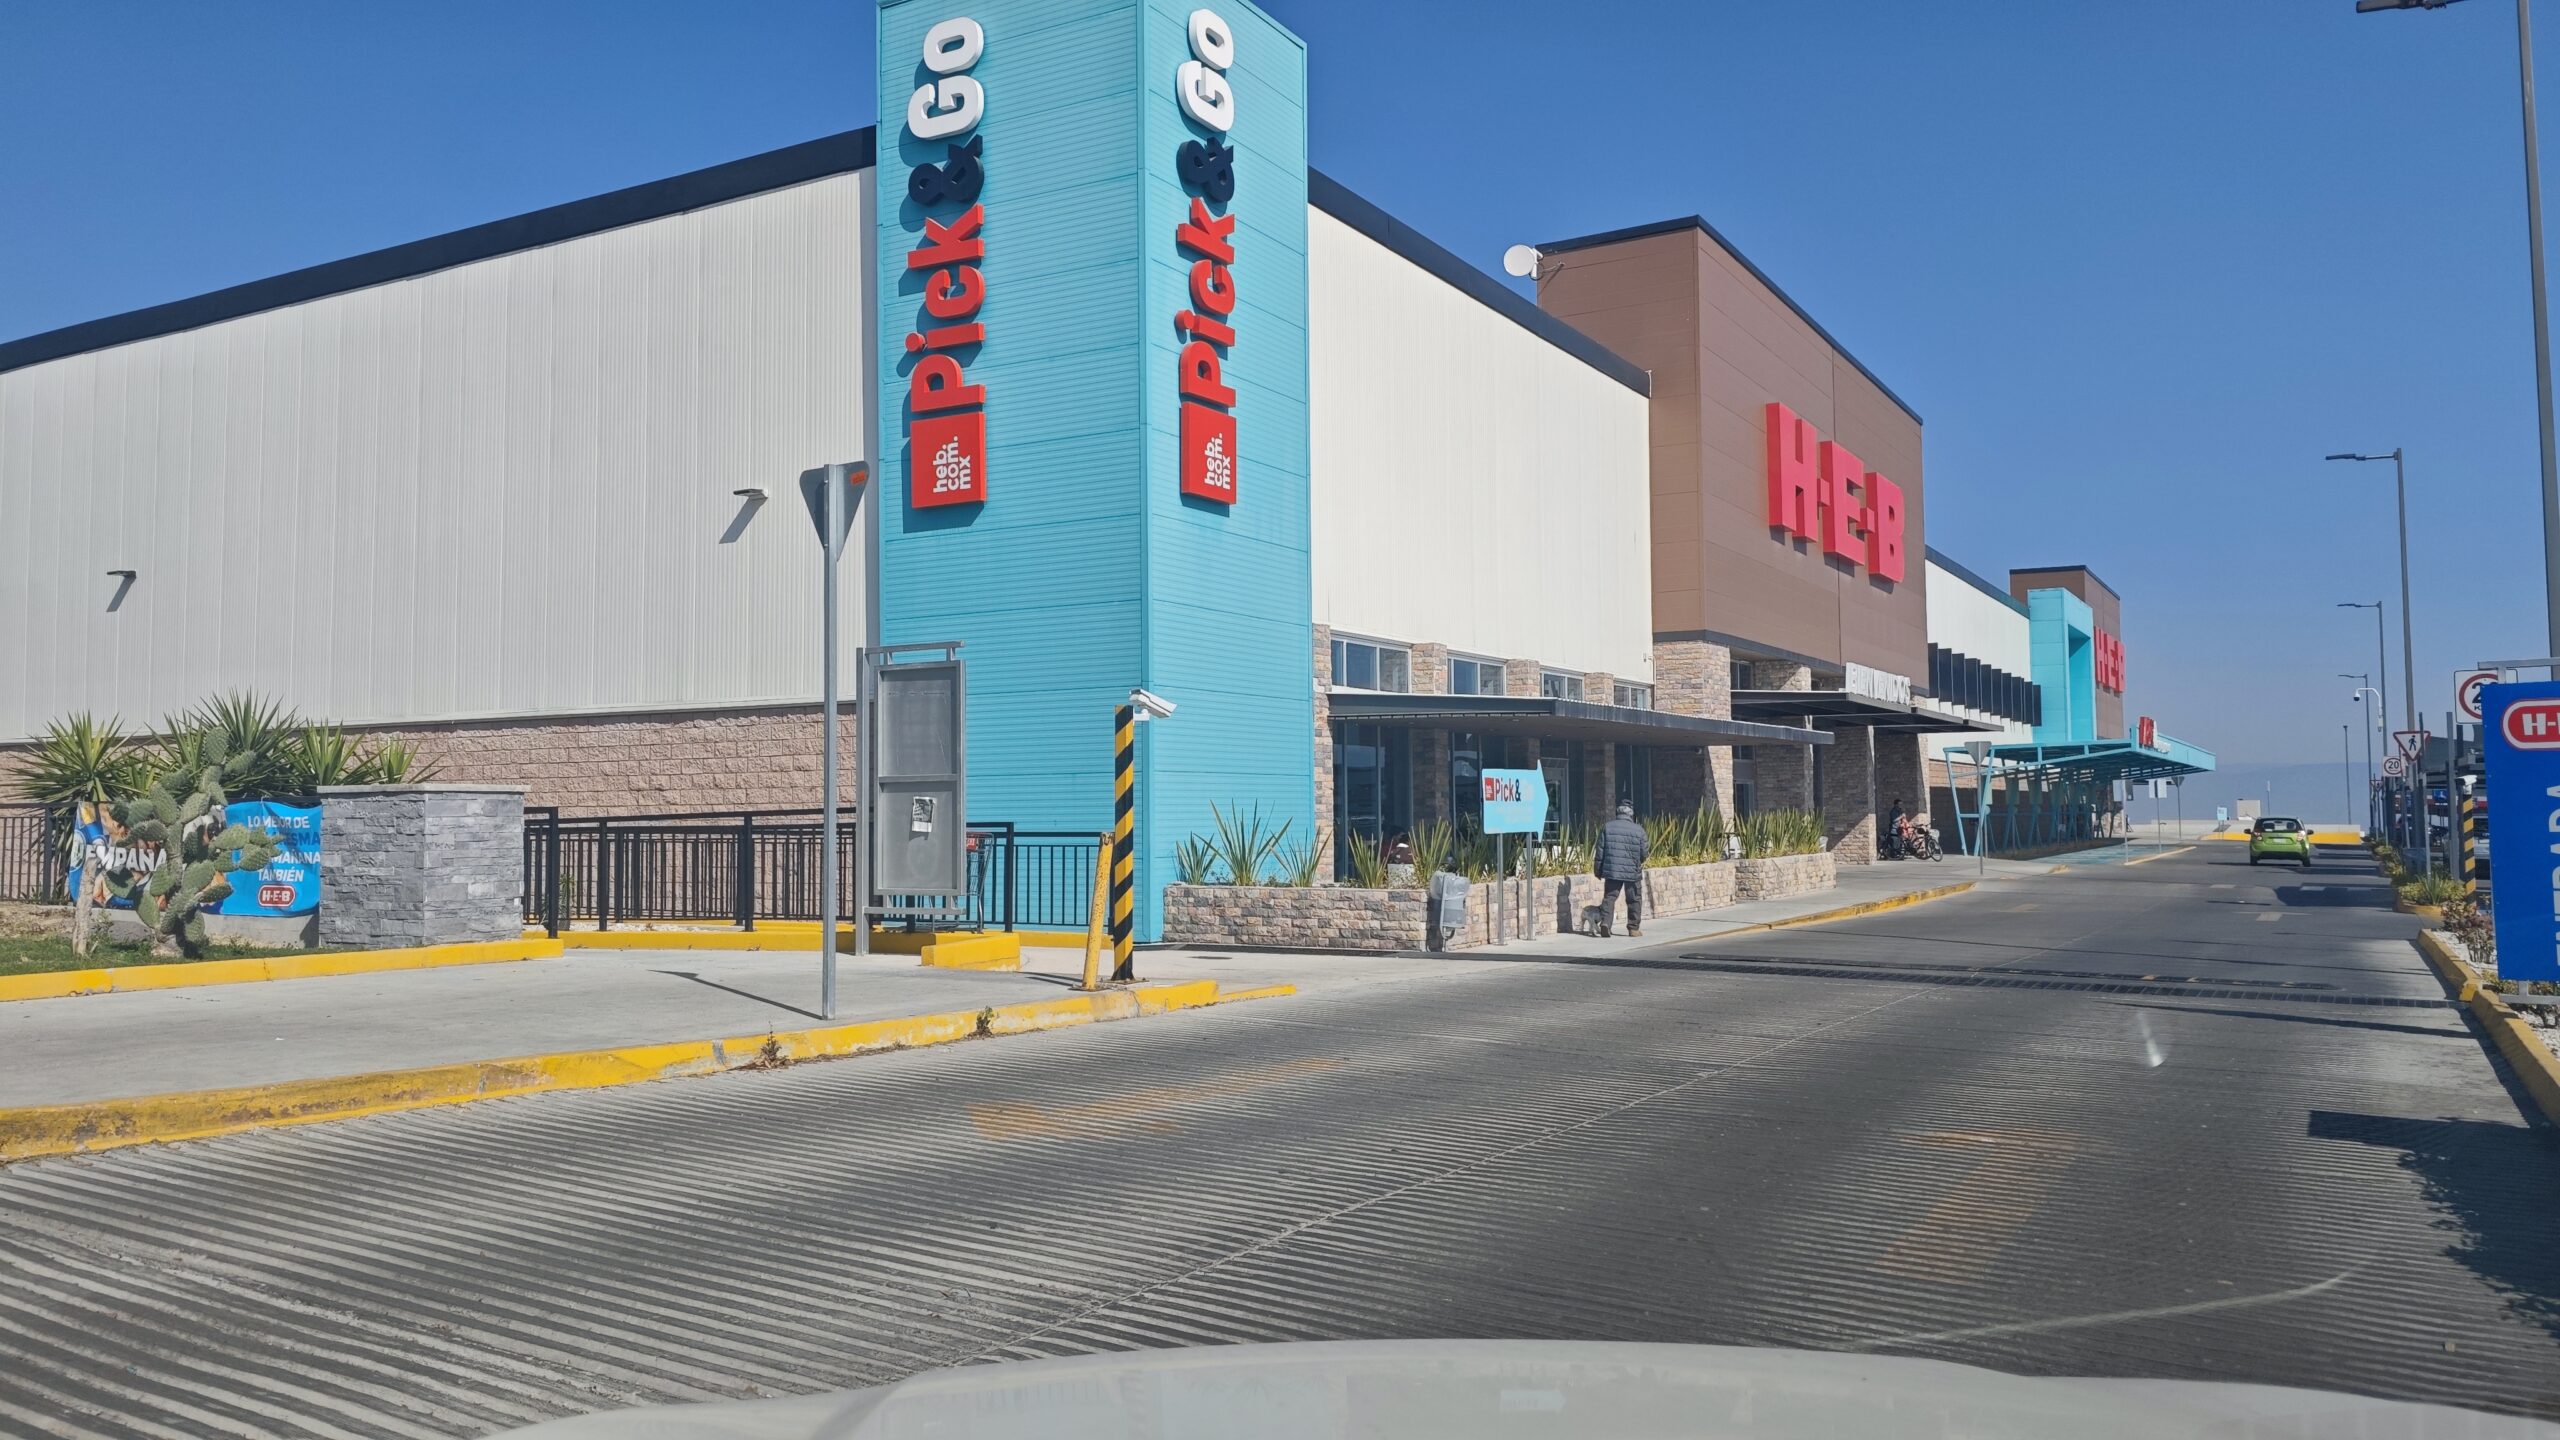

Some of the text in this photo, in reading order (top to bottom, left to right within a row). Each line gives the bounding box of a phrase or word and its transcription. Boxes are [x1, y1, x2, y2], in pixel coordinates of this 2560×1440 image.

[959, 455, 971, 490] mx
[1222, 455, 1231, 490] mx
[2388, 760, 2400, 769] 20
[247, 816, 310, 828] LO MEJOR DE
